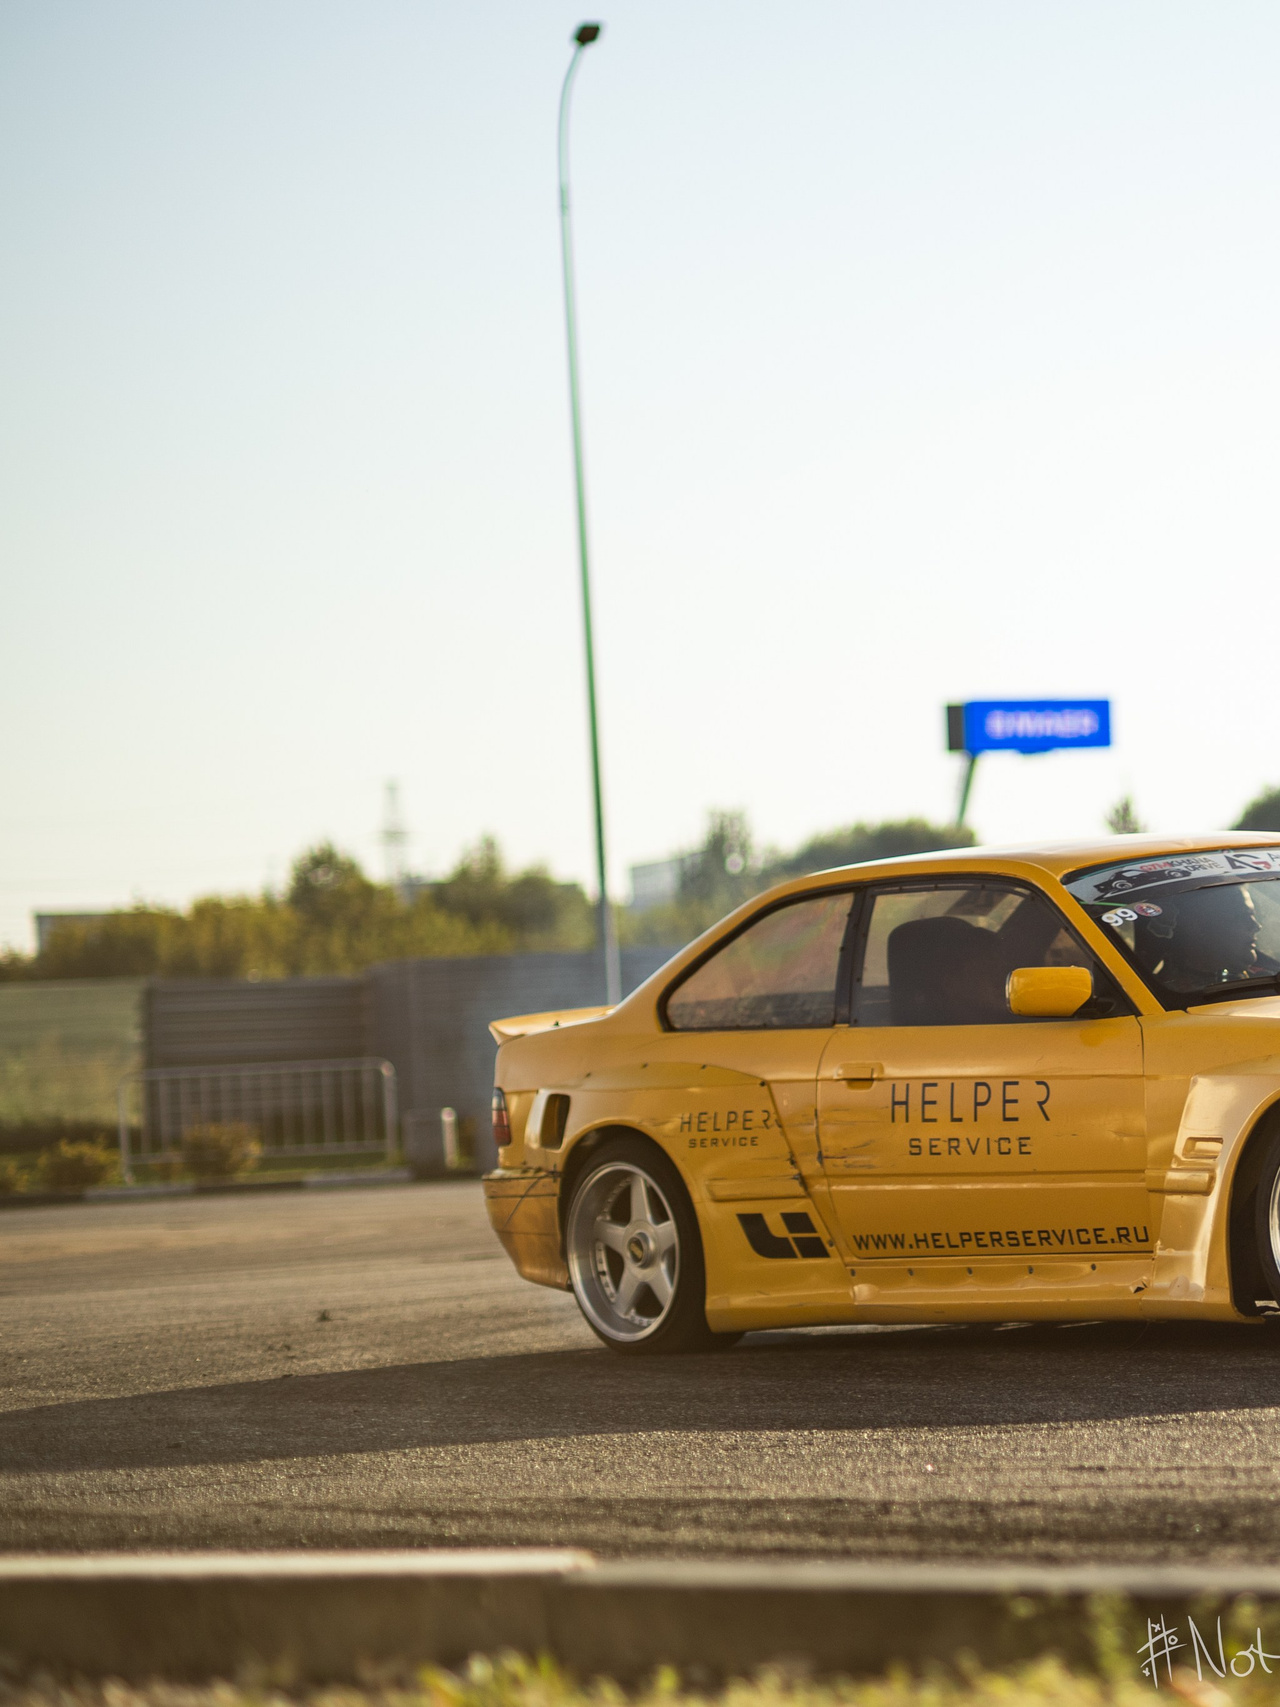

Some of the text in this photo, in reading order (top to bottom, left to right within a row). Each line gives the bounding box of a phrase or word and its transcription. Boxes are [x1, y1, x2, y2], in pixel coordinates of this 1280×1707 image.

[1101, 908, 1139, 927] 99
[890, 1080, 1052, 1124] HELPER
[680, 1110, 771, 1133] HELPER
[688, 1136, 759, 1149] SERVICE
[909, 1136, 1033, 1156] SERVICE
[852, 1226, 1150, 1251] WWW.HELPERSERVICE.RU
